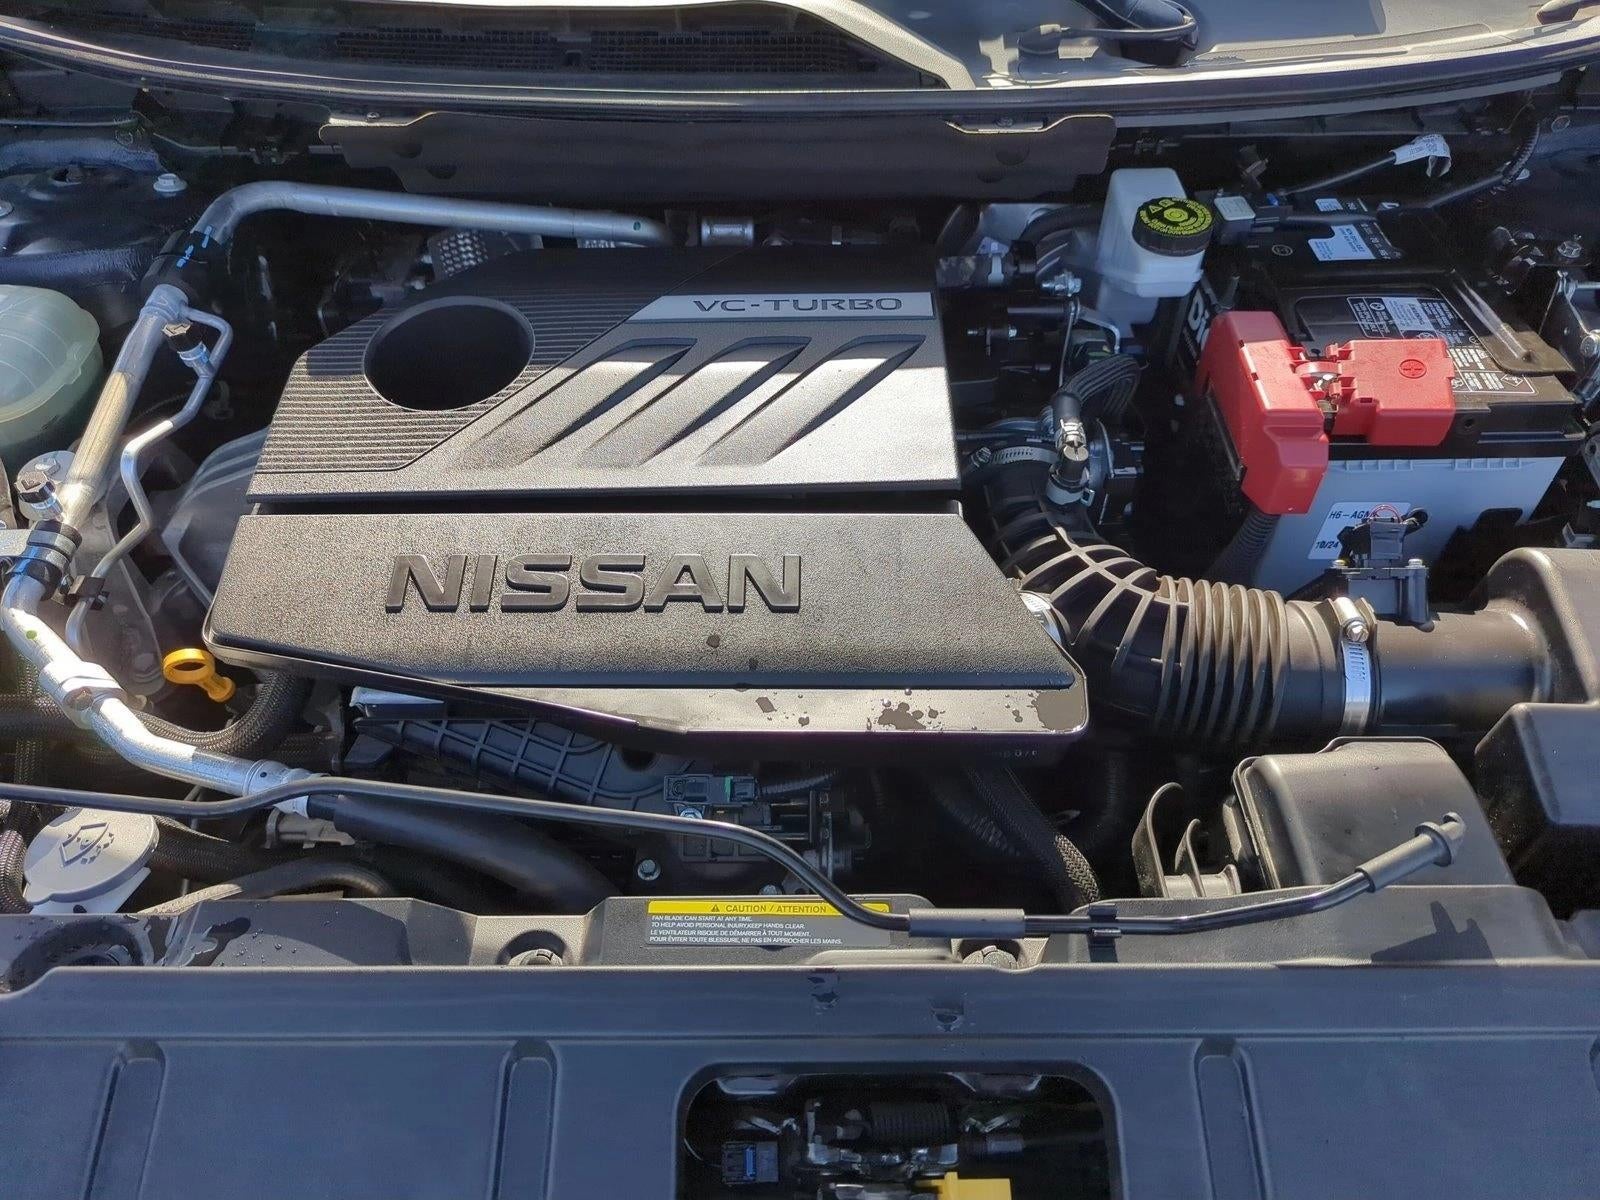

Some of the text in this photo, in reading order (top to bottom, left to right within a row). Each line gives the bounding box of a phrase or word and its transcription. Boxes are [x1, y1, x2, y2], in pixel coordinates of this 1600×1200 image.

[693, 298, 903, 312] VC-TURBO
[385, 553, 801, 614] NISSAN
[725, 904, 767, 913] CAUTION
[776, 905, 828, 914] ATTENTION
